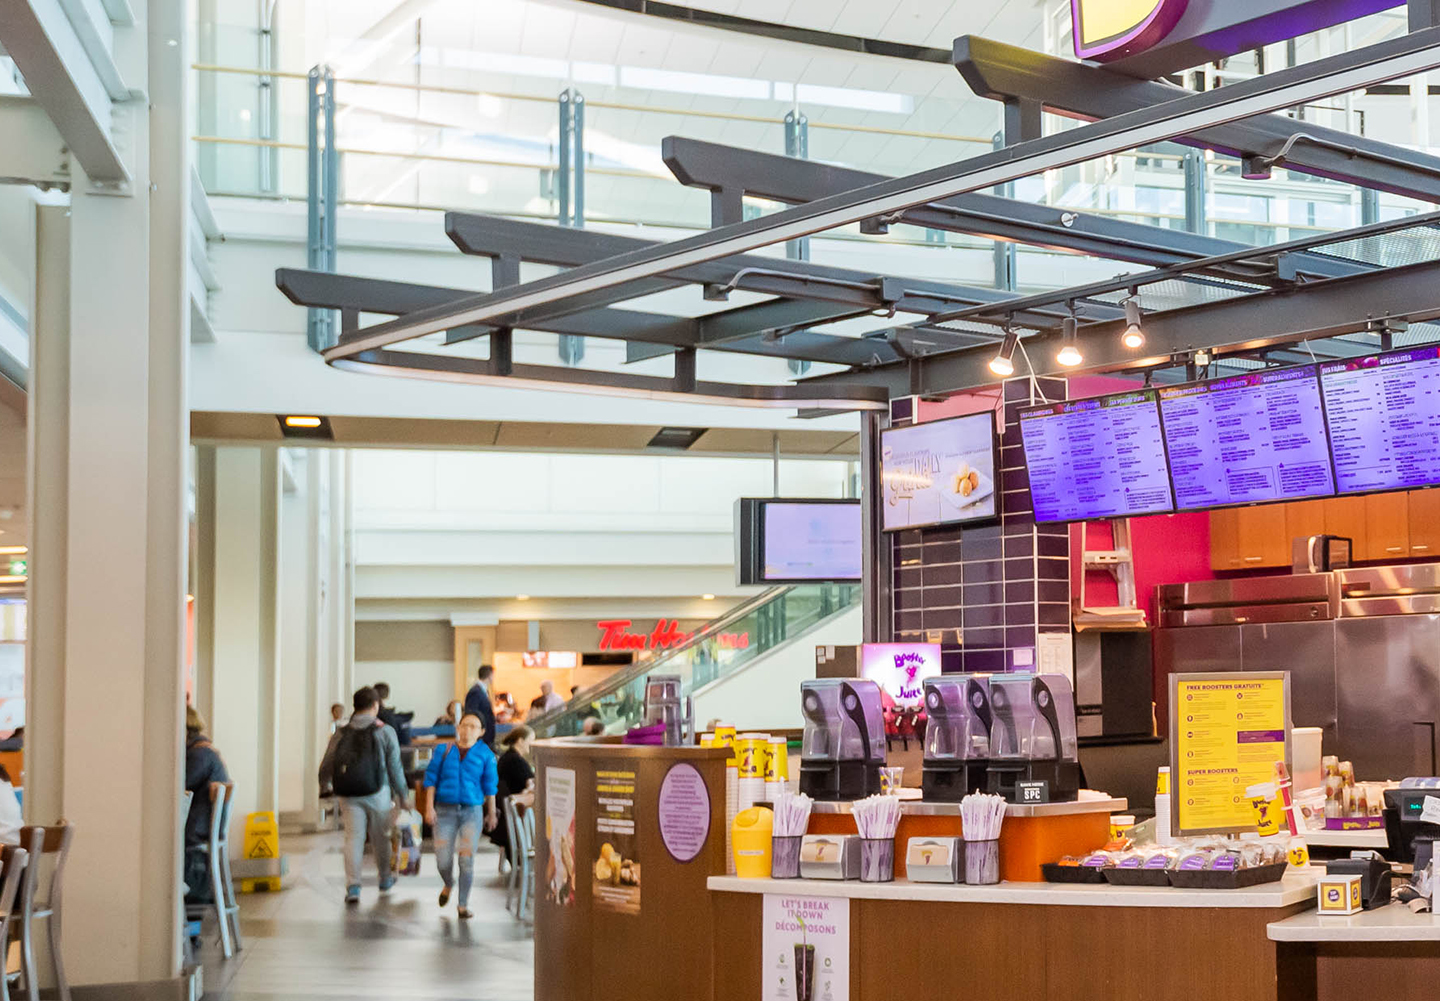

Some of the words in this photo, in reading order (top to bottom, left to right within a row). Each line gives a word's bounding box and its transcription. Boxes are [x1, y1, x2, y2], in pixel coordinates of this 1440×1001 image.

[597, 620, 647, 650] Tim
[782, 900, 801, 908] LET'S
[803, 901, 829, 910] BREAK
[797, 910, 823, 919] DOWN
